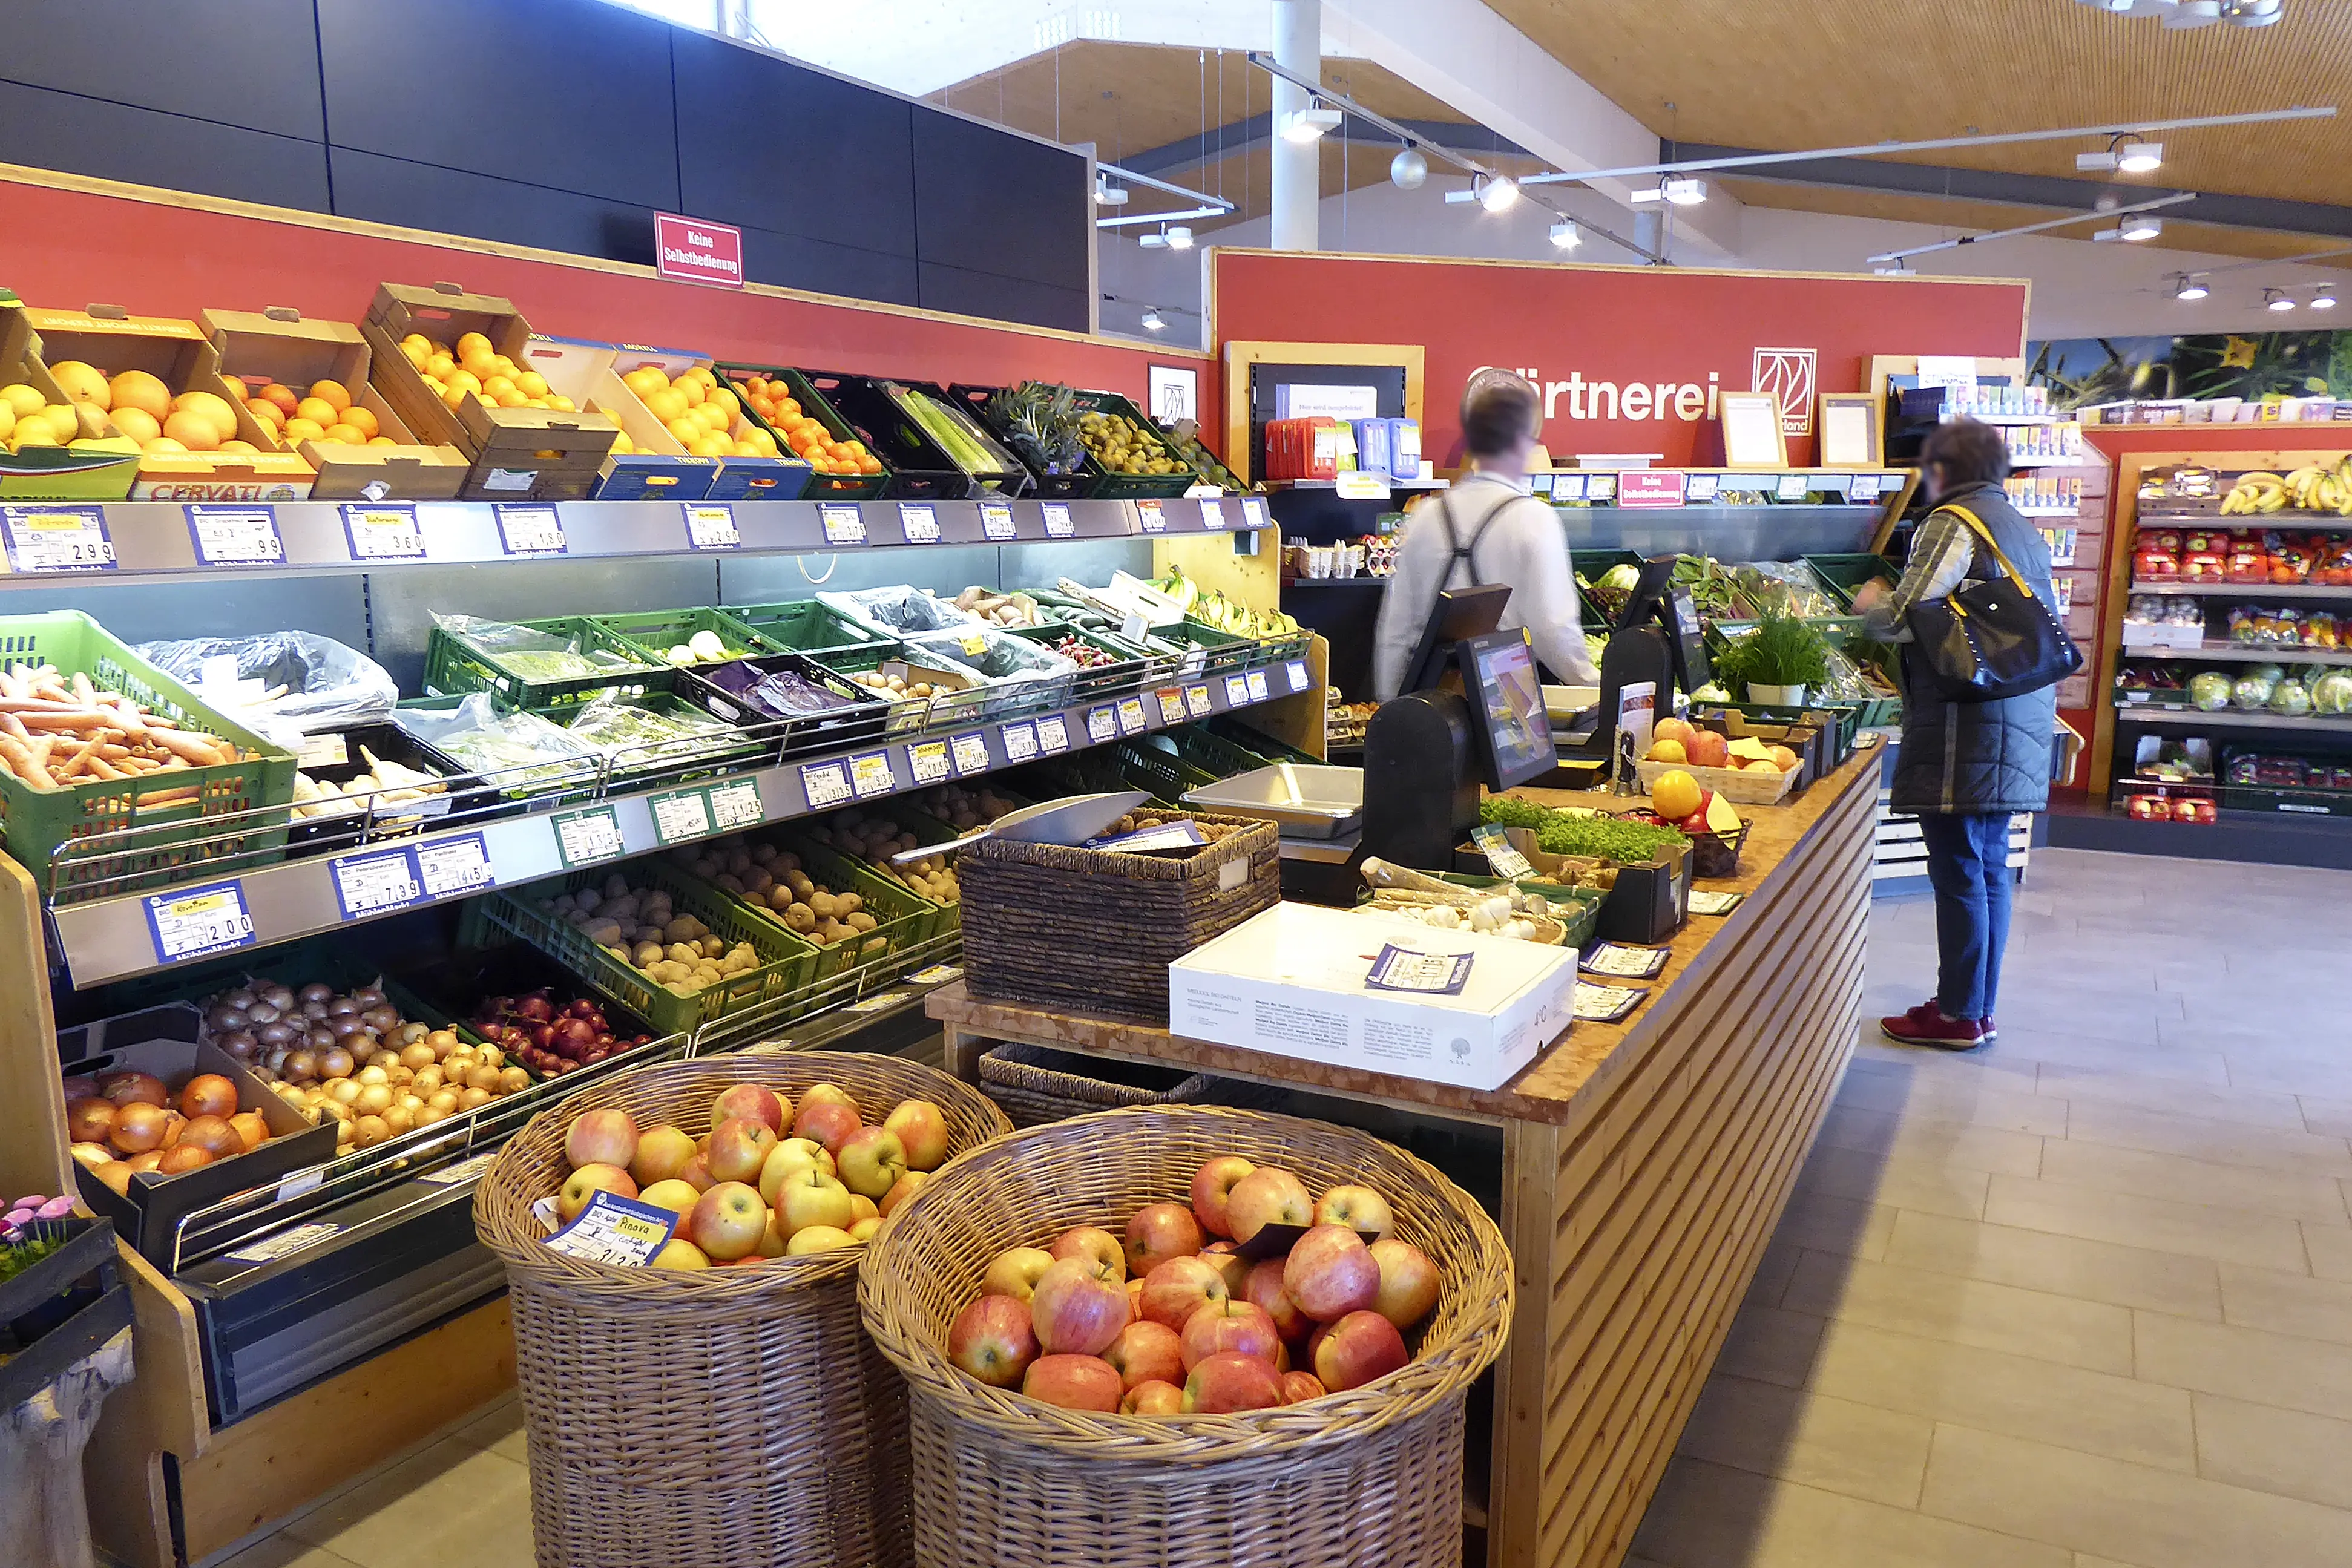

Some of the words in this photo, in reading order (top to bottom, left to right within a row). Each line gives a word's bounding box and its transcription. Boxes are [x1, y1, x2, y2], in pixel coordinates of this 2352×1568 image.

[688, 230, 714, 248] Keine
[664, 246, 738, 275] Selbstbedienung
[1467, 366, 1718, 421] ärtnerei
[1641, 476, 1662, 486] Keine
[151, 484, 263, 502] CERVATI
[1623, 489, 1680, 499] Selbstbedienung
[619, 1216, 650, 1235] Pinova
